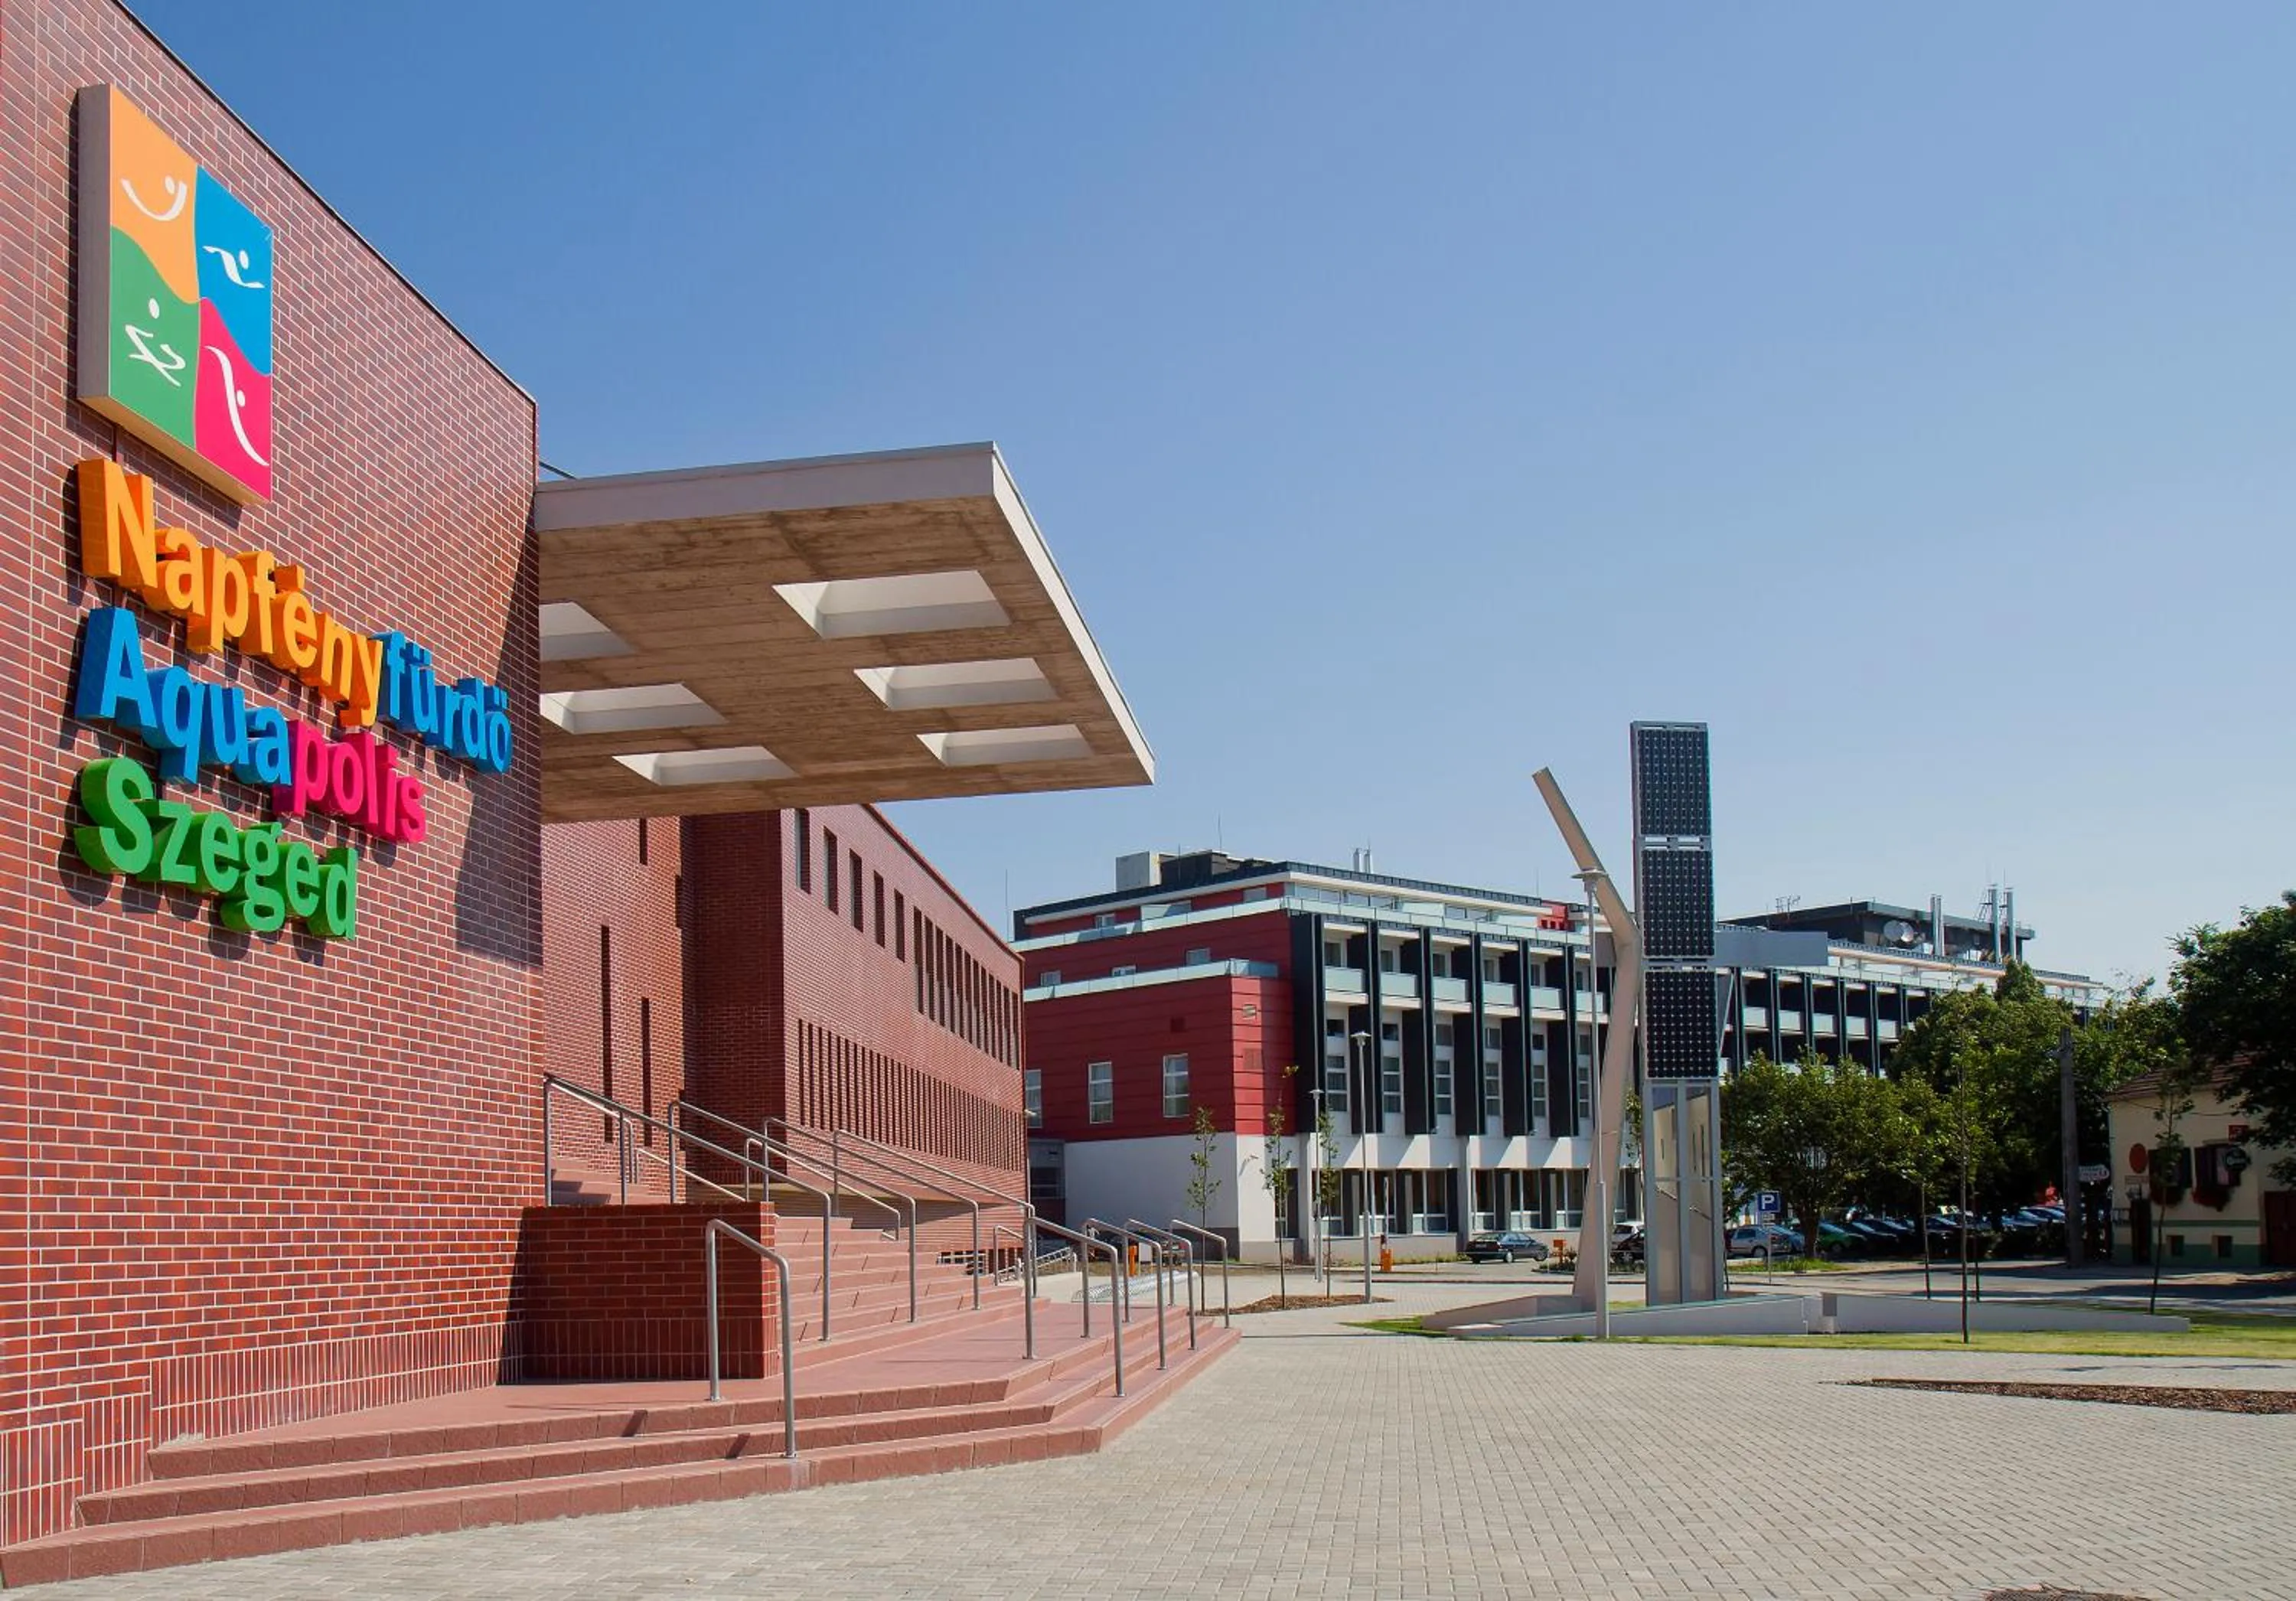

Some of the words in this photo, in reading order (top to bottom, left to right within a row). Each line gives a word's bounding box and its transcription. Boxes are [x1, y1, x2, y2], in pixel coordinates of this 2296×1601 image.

[75, 607, 426, 843] Aquapolis
[74, 756, 358, 941] Szeged
[1761, 1195, 1775, 1209] P
